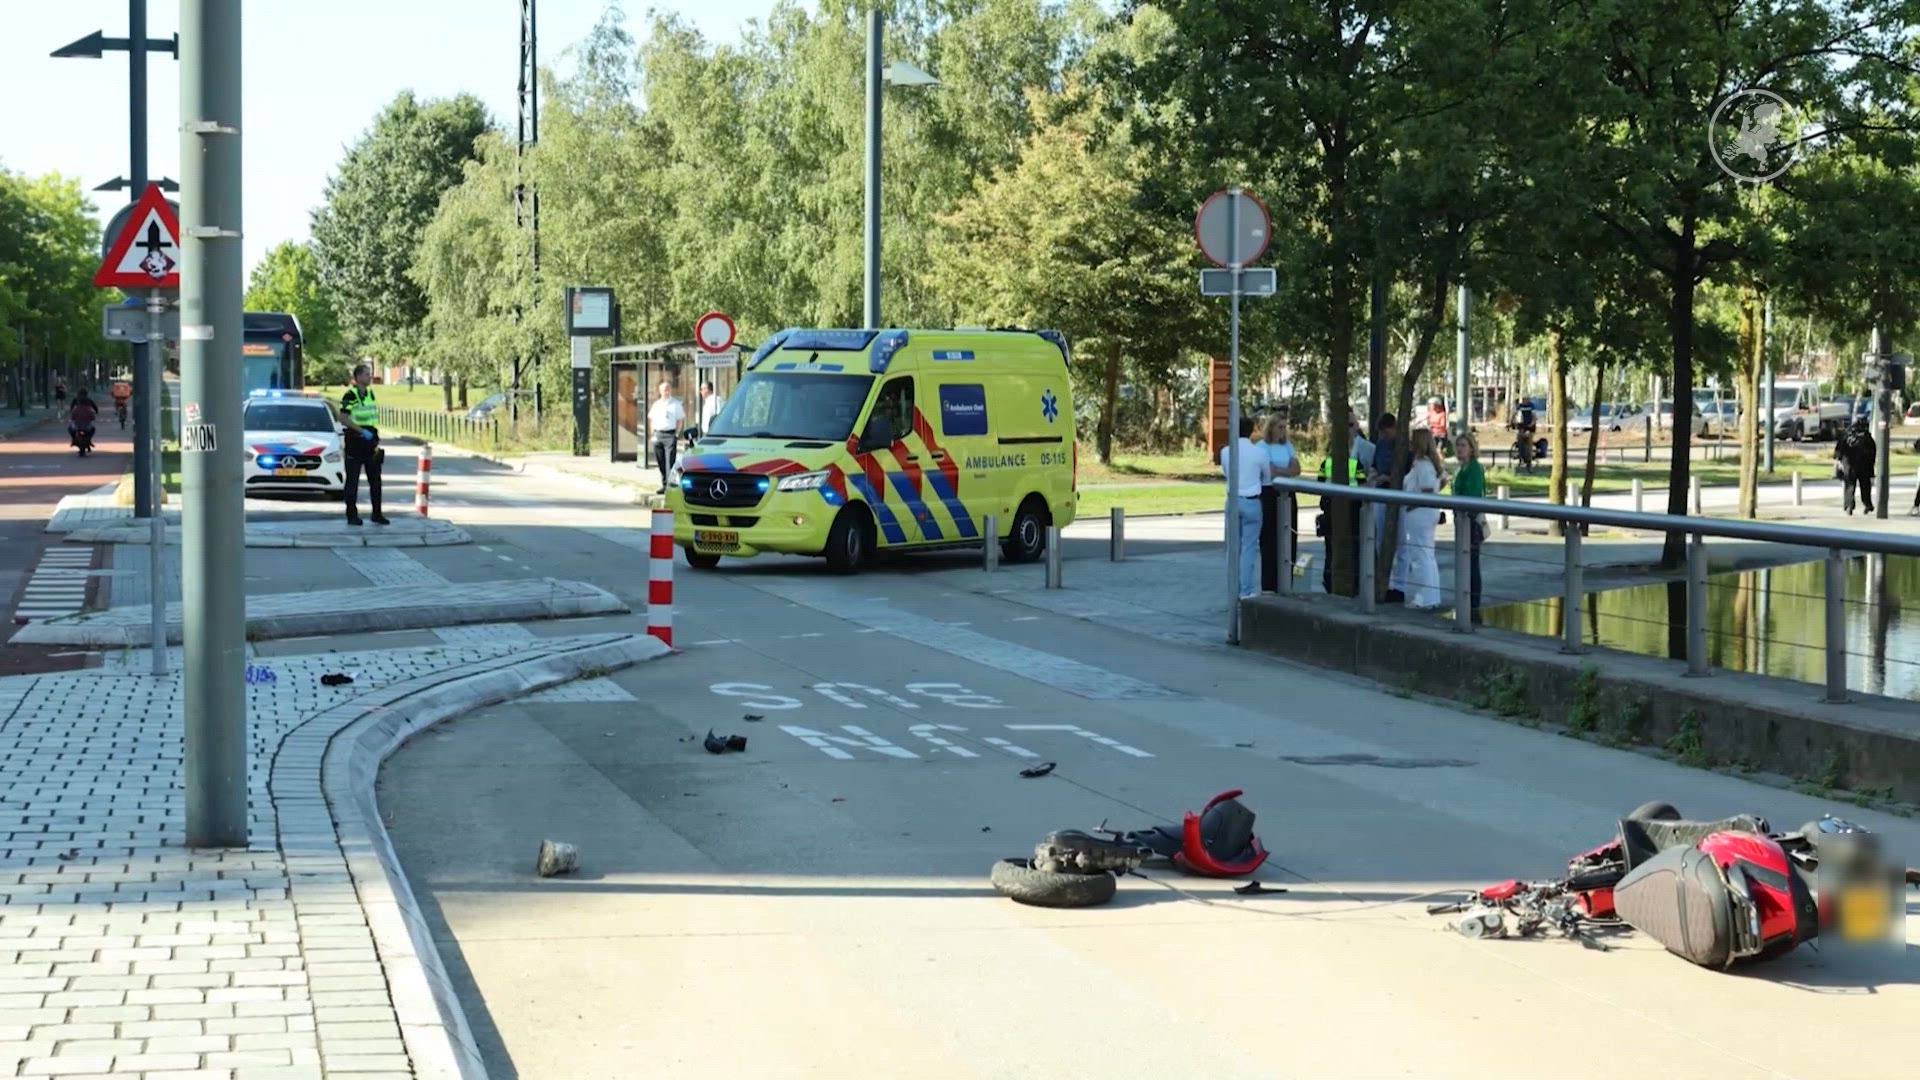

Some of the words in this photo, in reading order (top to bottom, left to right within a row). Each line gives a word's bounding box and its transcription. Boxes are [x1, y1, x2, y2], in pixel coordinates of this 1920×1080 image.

[965, 454, 1026, 469] AMBULANCE
[1040, 452, 1066, 465] 05-115
[709, 682, 1016, 710] BUS
